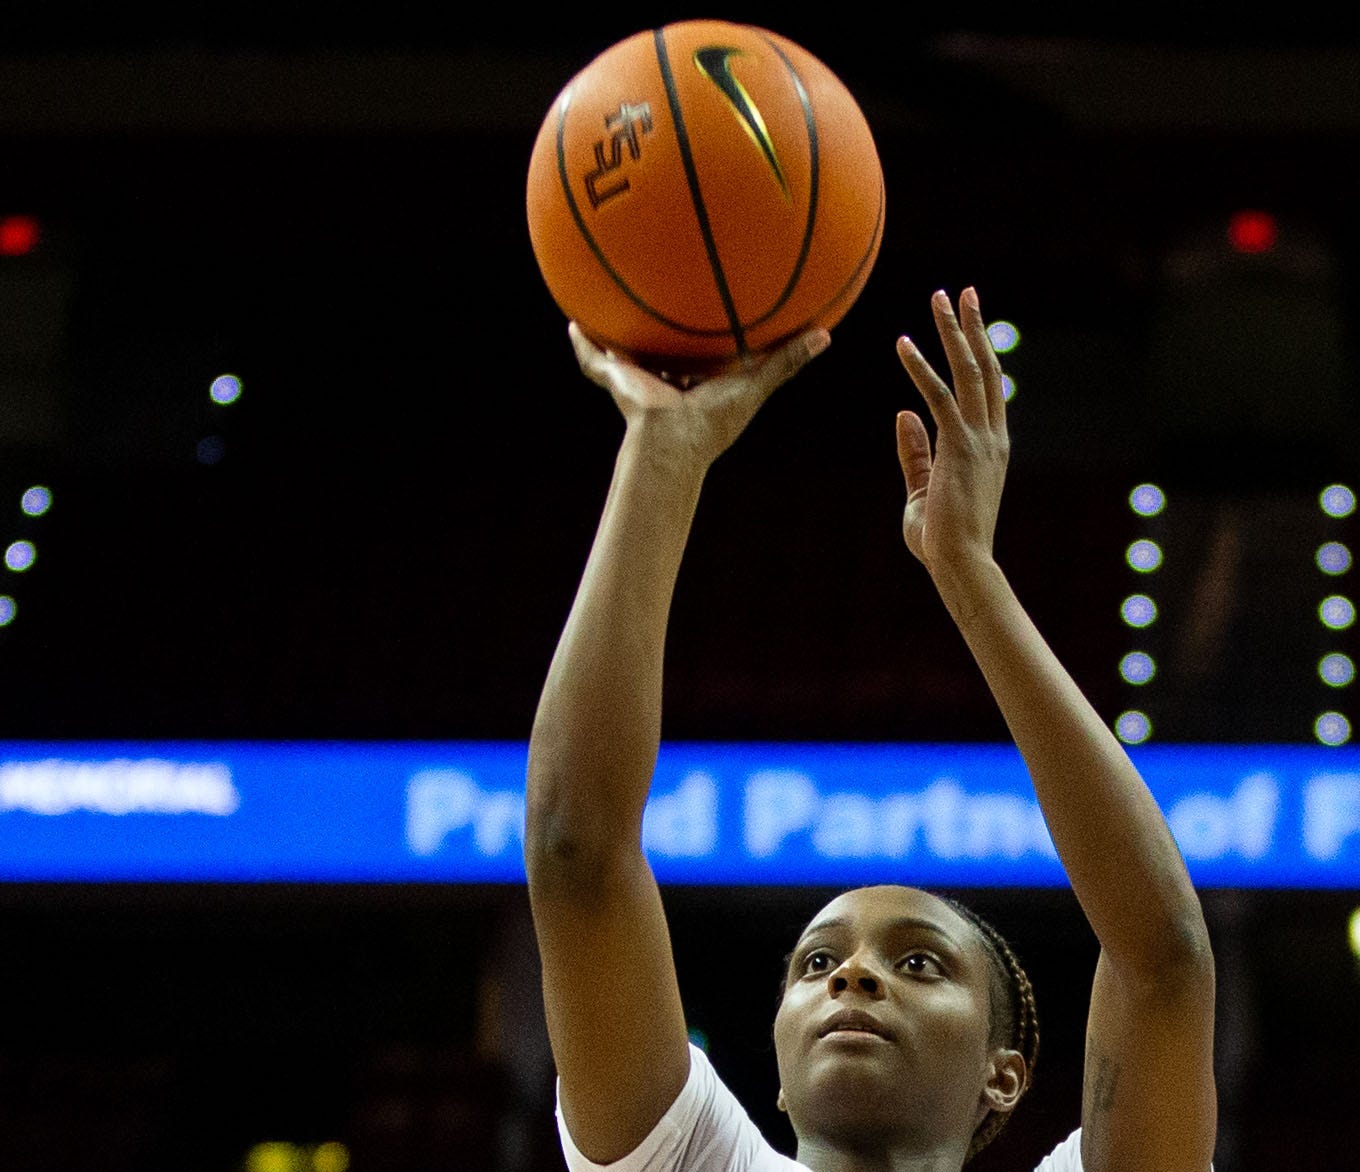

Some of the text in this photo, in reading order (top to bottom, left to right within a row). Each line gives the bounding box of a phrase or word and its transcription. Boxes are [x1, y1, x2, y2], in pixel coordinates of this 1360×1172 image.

[584, 102, 654, 209] FSU
[406, 769, 717, 855] Prd
[1167, 772, 1279, 860] of
